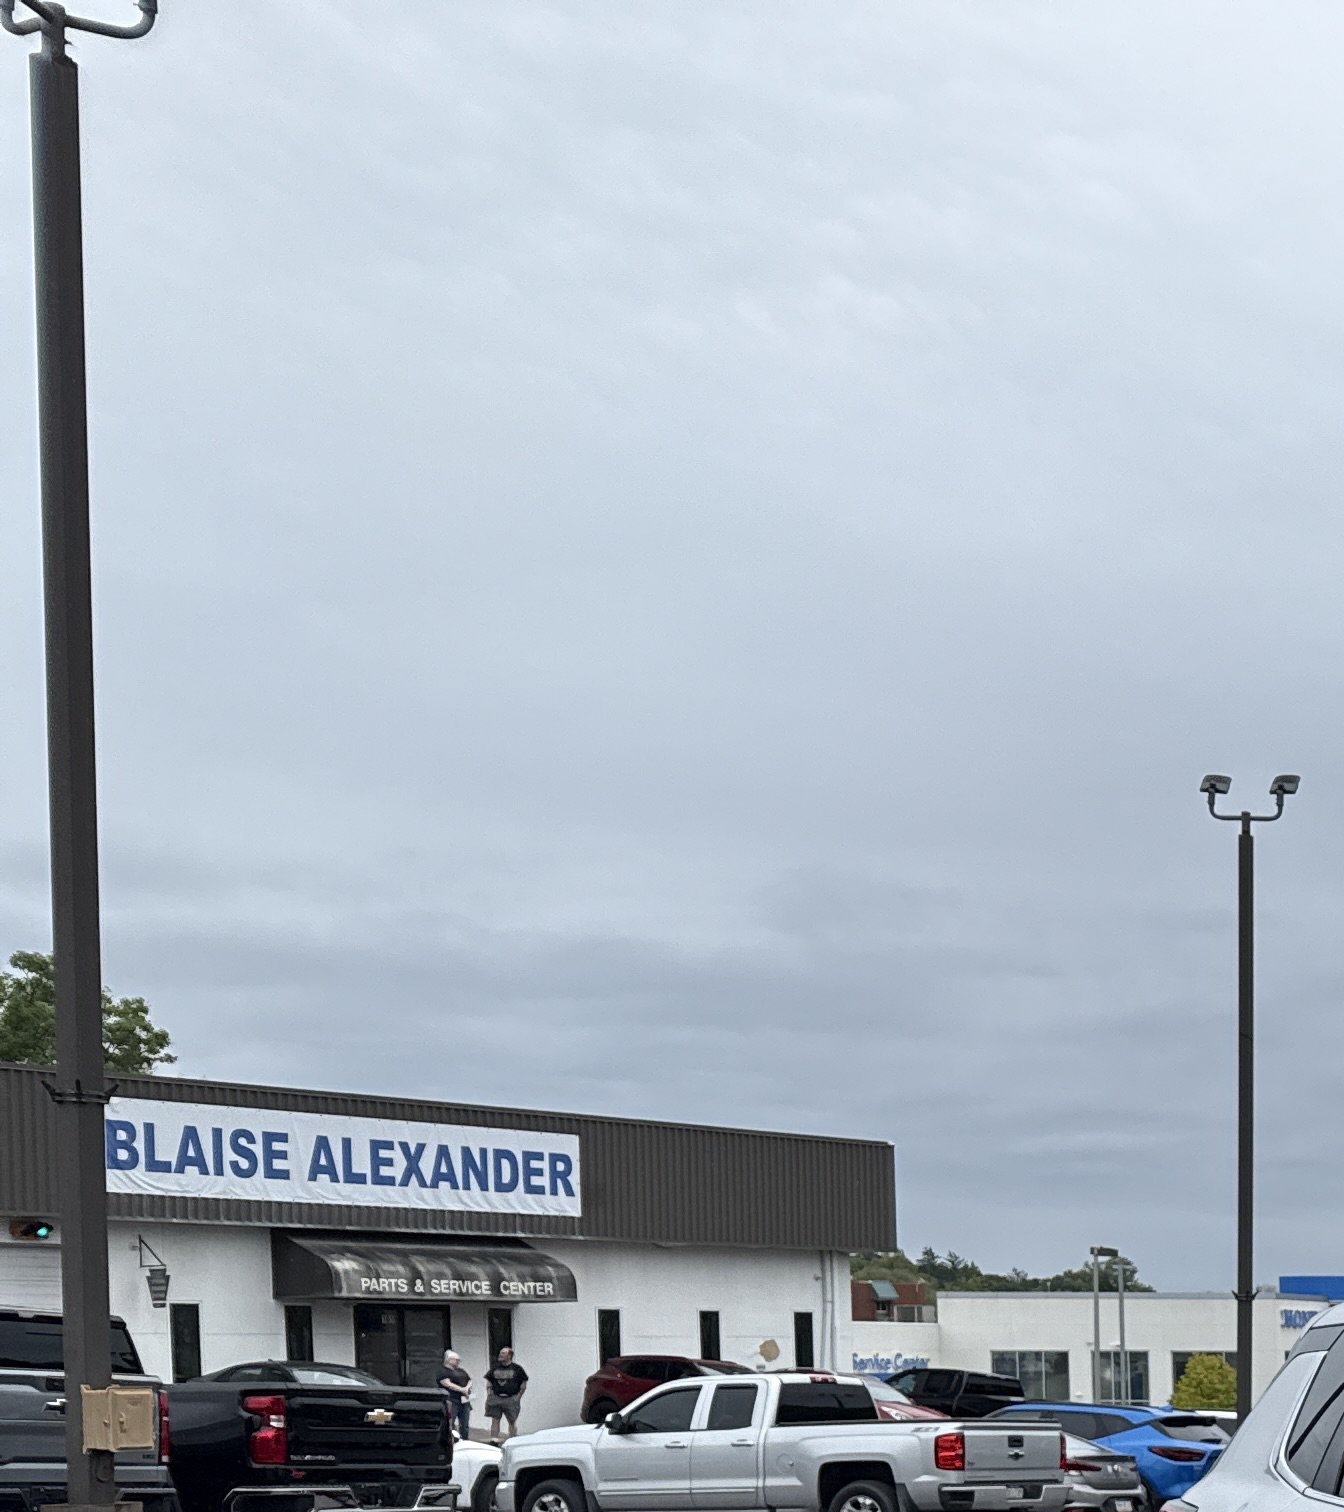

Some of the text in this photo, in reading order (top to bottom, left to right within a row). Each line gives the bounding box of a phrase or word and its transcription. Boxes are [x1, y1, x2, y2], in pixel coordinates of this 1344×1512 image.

[105, 1118, 576, 1198] BLAISE ALEXANDER
[361, 1277, 555, 1296] PARTS & SERVICE CENTER
[852, 1352, 930, 1371] Service Center
